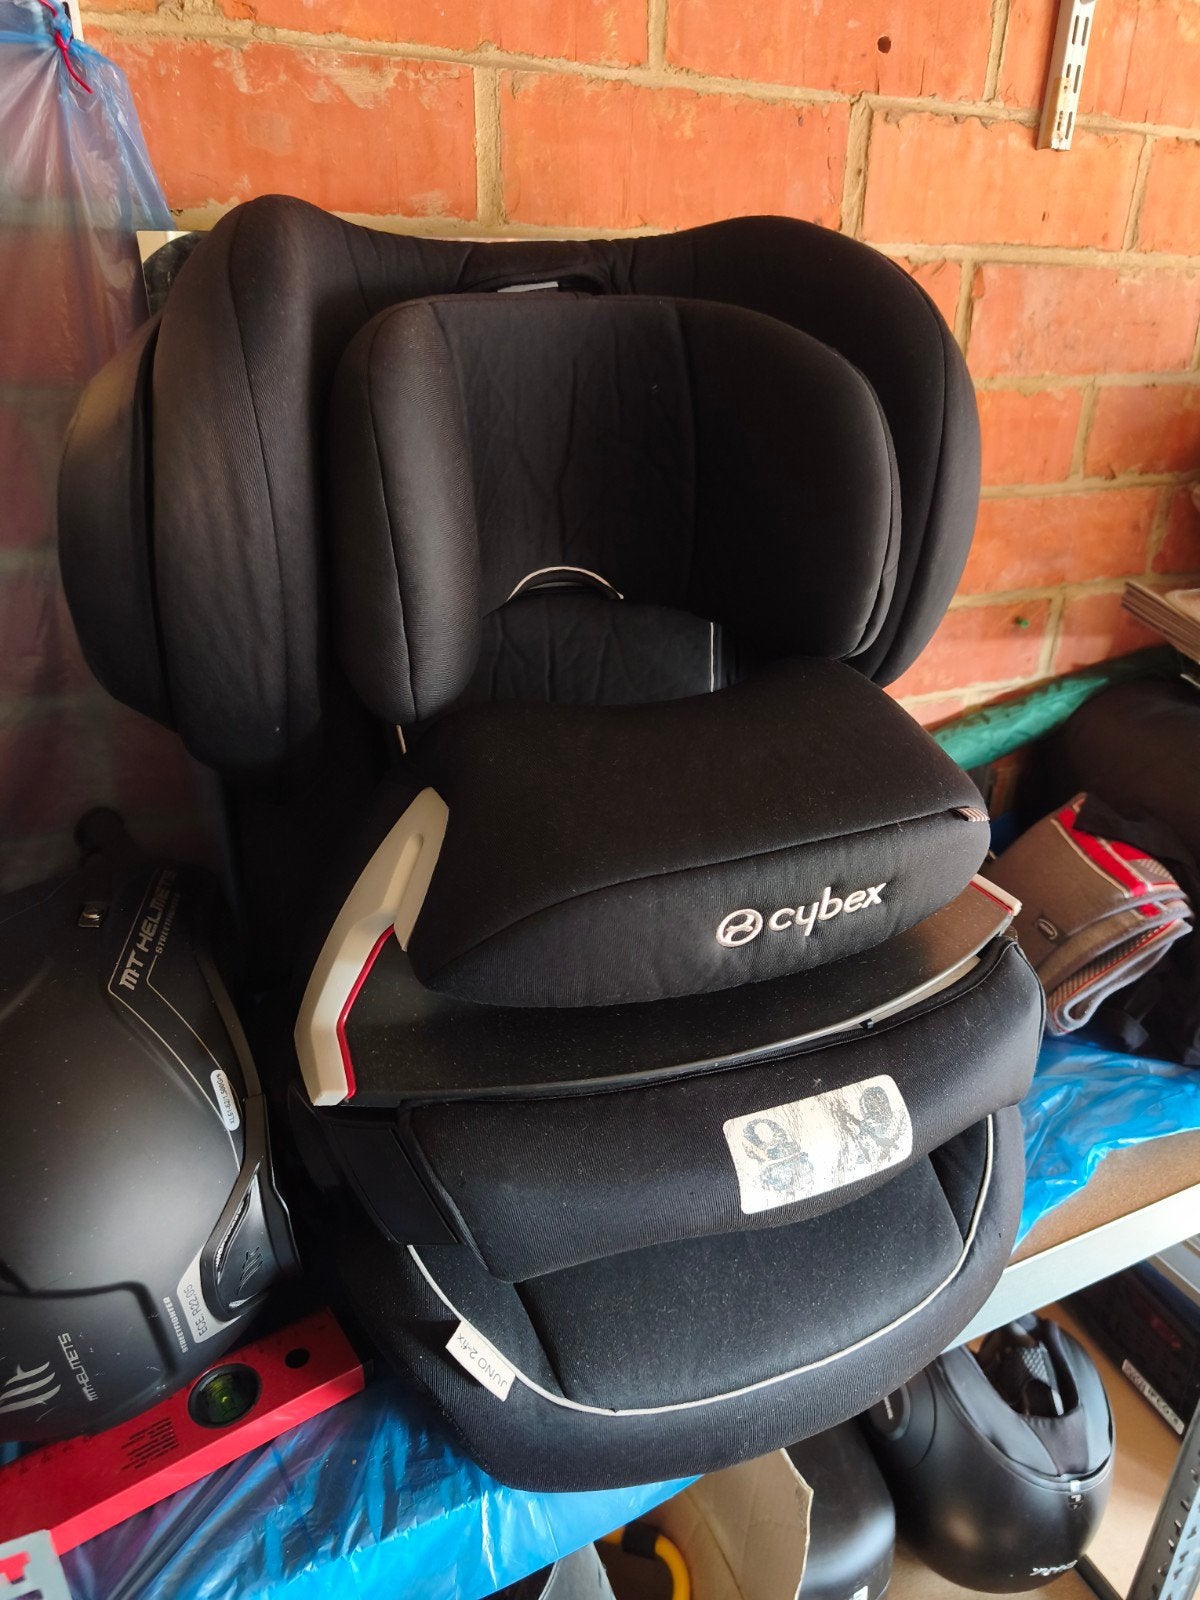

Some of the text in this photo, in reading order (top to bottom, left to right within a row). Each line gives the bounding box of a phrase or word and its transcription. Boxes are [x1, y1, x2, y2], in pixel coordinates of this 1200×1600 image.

[768, 883, 887, 937] cybex
[119, 948, 145, 991] MT
[162, 1296, 189, 1353] STREETFIGHTER
[457, 1332, 508, 1388] JUNO 2-fix
